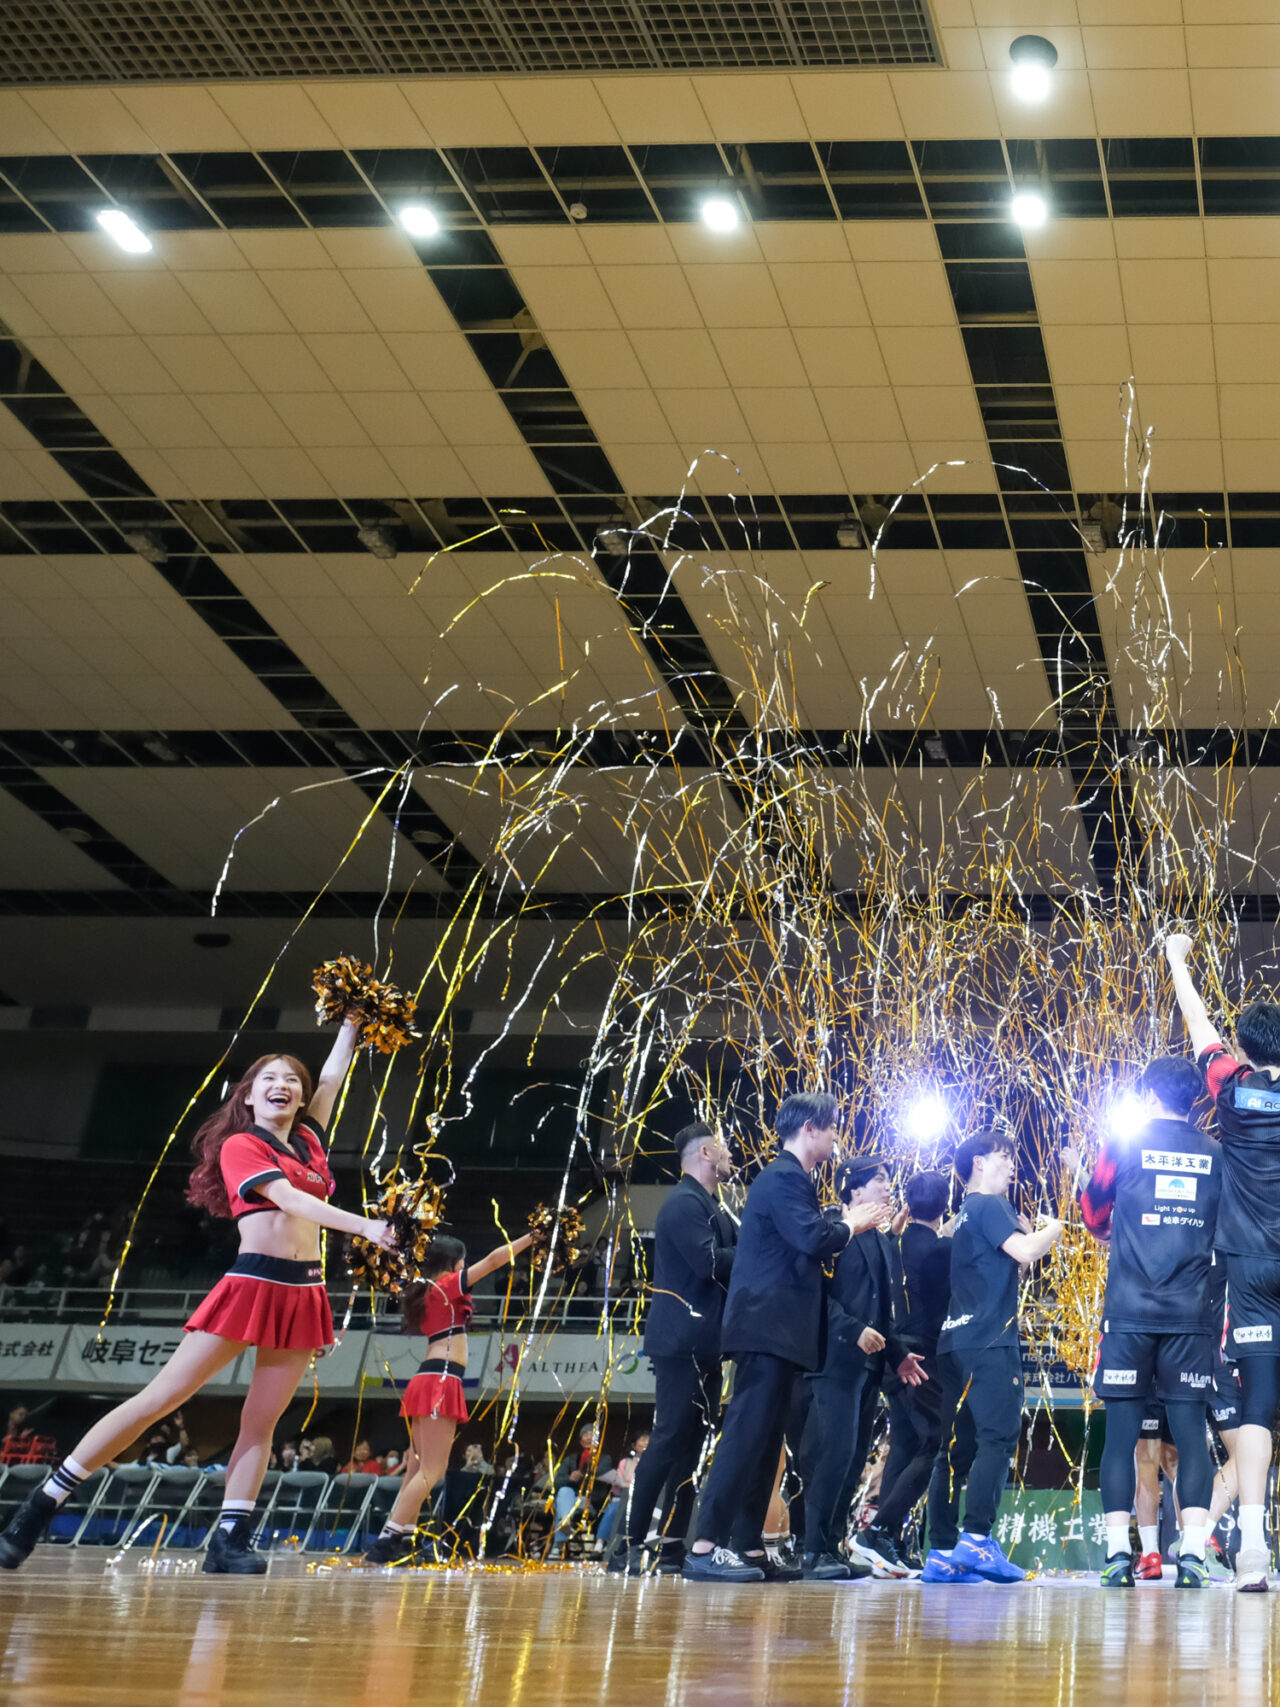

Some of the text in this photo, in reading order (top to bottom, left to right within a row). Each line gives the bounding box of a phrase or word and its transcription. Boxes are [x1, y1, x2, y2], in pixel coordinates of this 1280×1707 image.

[1144, 1154, 1209, 1170] 太平洋工業
[1154, 1205, 1170, 1213] Light
[527, 1361, 598, 1374] ALTHEA
[997, 1511, 1108, 1546] 精機工業
